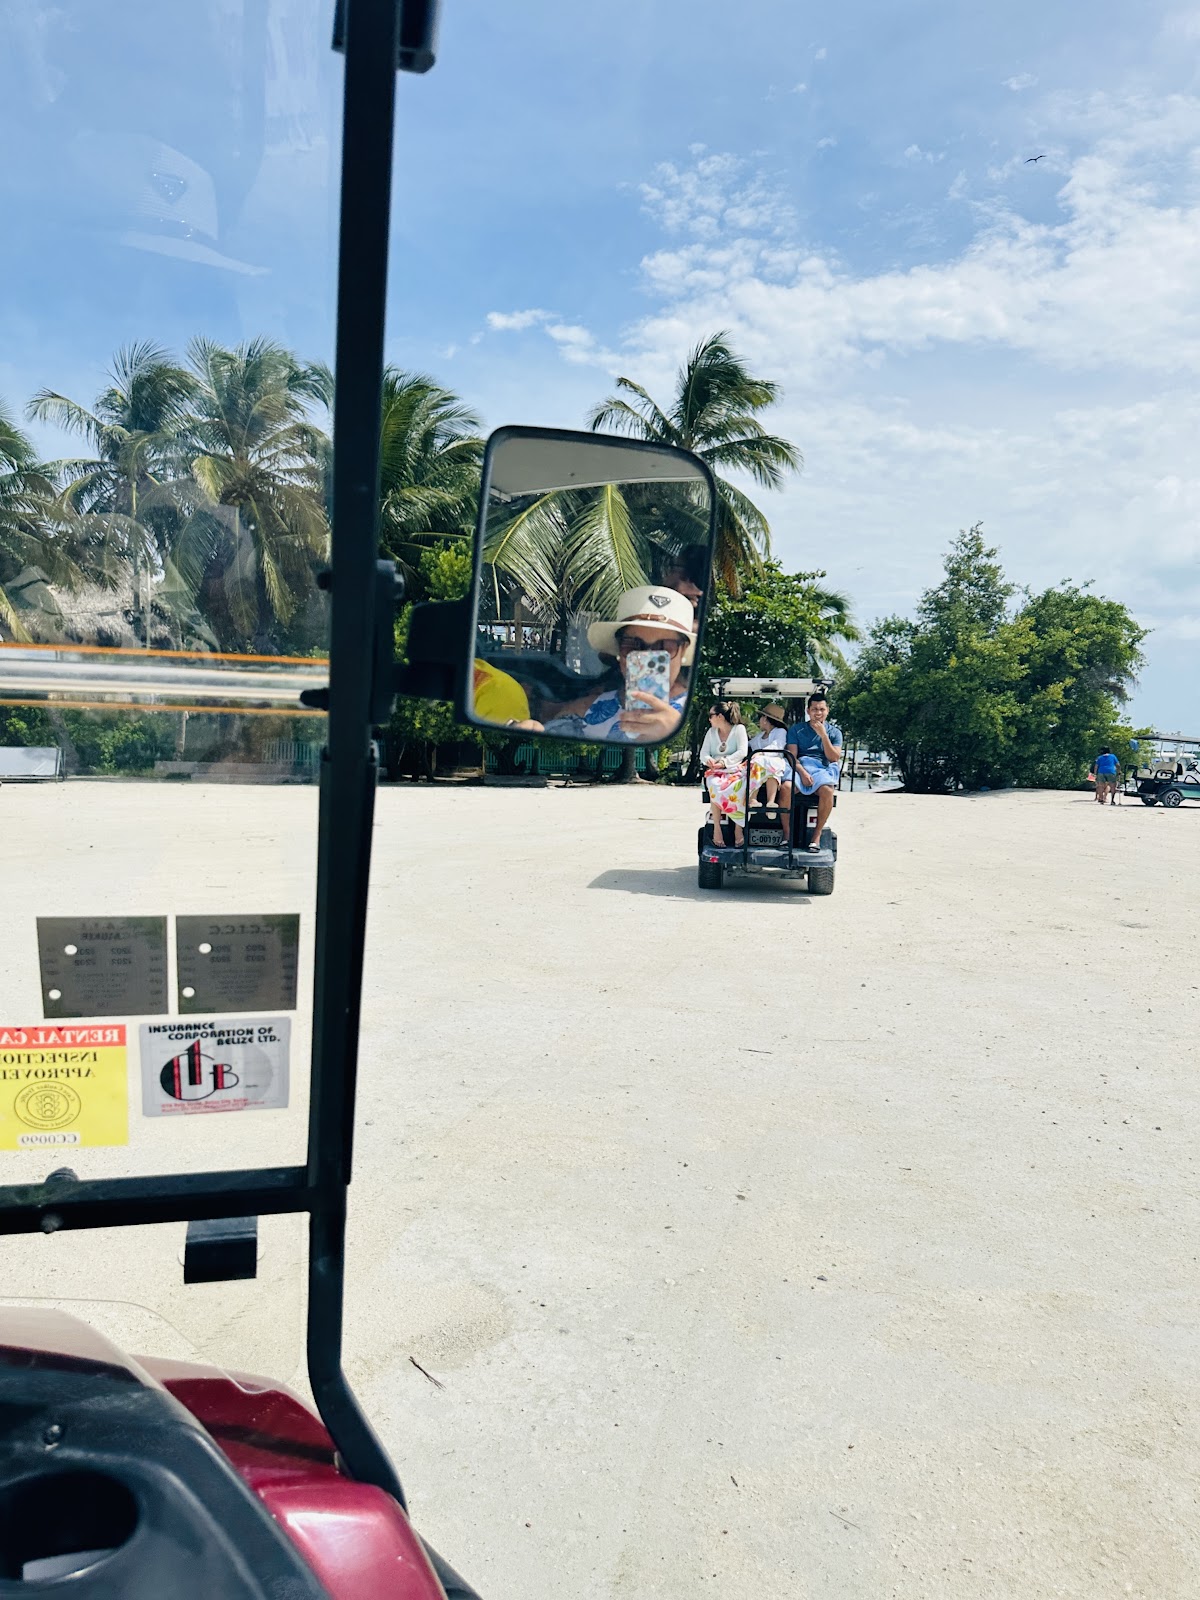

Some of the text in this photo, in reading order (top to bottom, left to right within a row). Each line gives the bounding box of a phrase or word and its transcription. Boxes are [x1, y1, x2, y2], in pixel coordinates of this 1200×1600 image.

[149, 1022, 215, 1033] INSURANCE
[168, 1026, 273, 1041] CORPORATION OF
[217, 1034, 280, 1046] BELIZE LTD.
